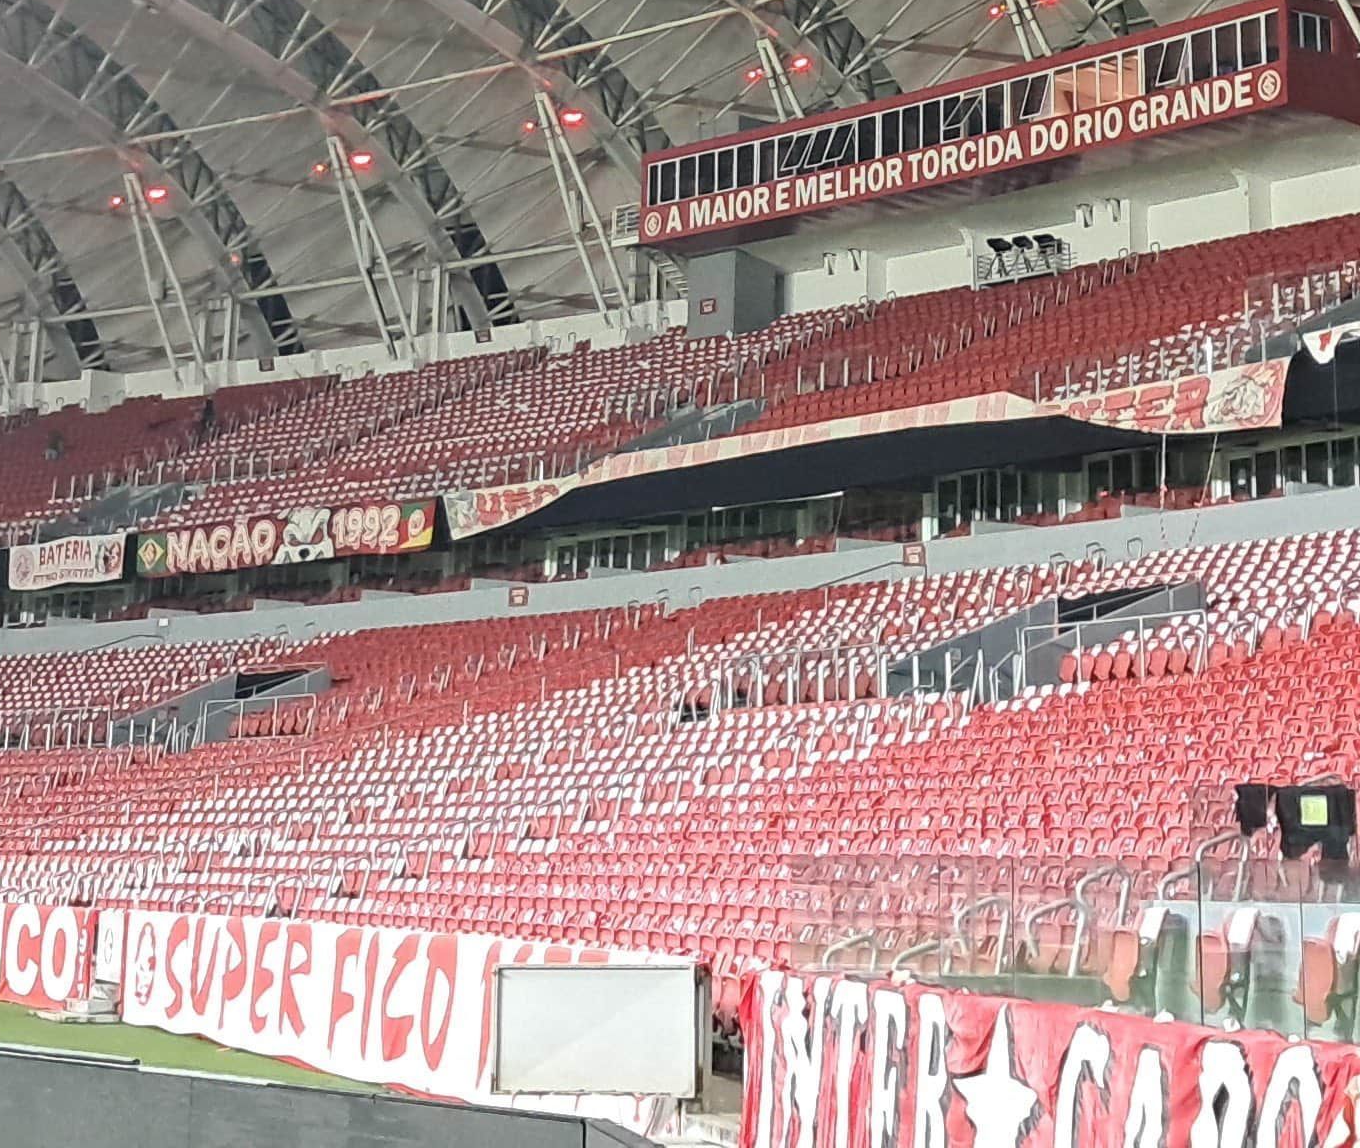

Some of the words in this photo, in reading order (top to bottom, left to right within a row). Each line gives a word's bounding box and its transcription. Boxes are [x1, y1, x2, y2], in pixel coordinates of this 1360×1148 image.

[665, 208, 683, 235] A
[688, 185, 770, 230] MAIOR
[774, 182, 792, 212] E
[794, 156, 904, 209] MELHOR
[906, 129, 1024, 184] TORCIDA
[1029, 119, 1070, 157] DO
[1073, 109, 1124, 148] RIO
[1127, 70, 1255, 135] GRANDE
[39, 539, 92, 566] BATERIA
[331, 504, 402, 554] 1992
[164, 915, 313, 1039] SUPER
[327, 927, 459, 1072] FICO
